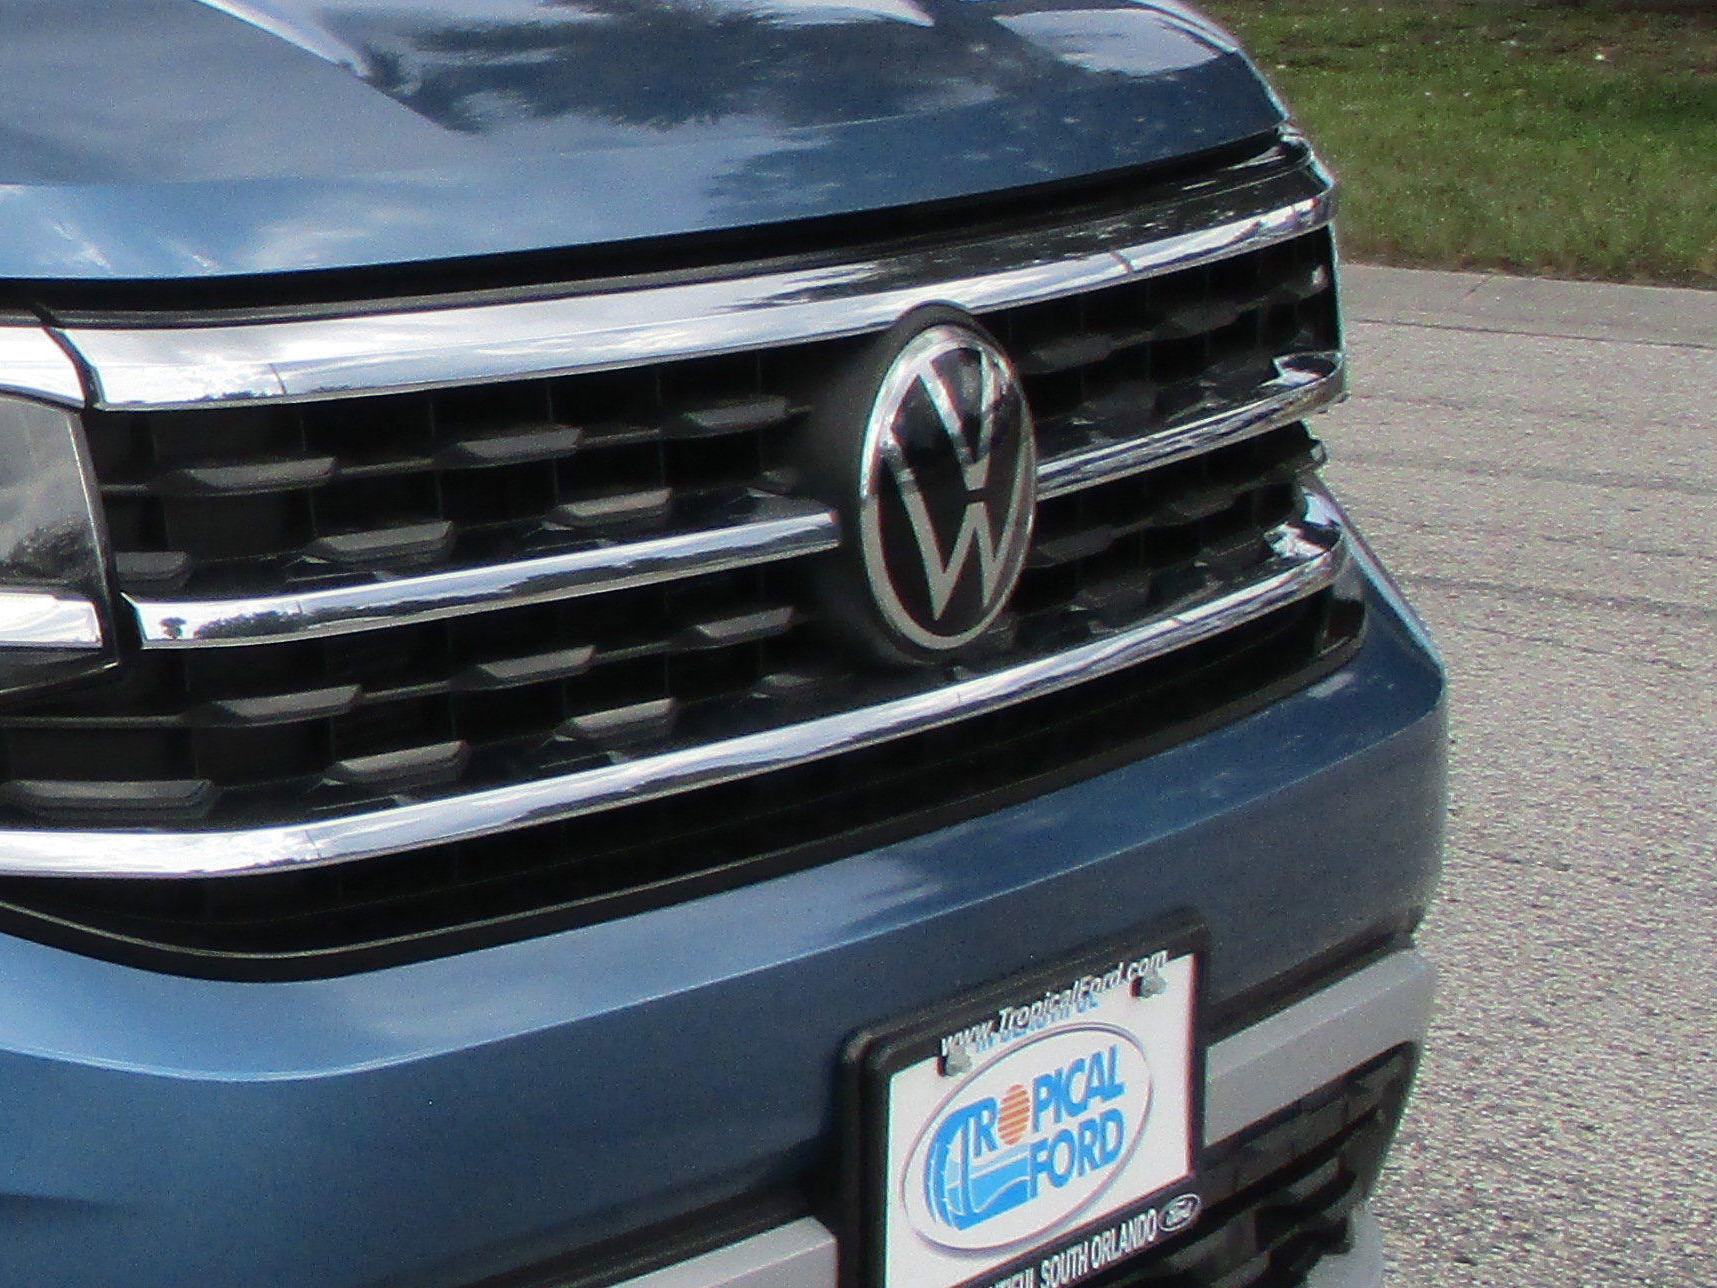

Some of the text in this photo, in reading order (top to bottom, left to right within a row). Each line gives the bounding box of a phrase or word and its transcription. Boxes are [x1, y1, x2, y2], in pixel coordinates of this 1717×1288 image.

[935, 1043, 1127, 1174] TROPICAL
[1028, 1108, 1125, 1198] FORD
[1091, 1208, 1157, 1269] ORLANDO
